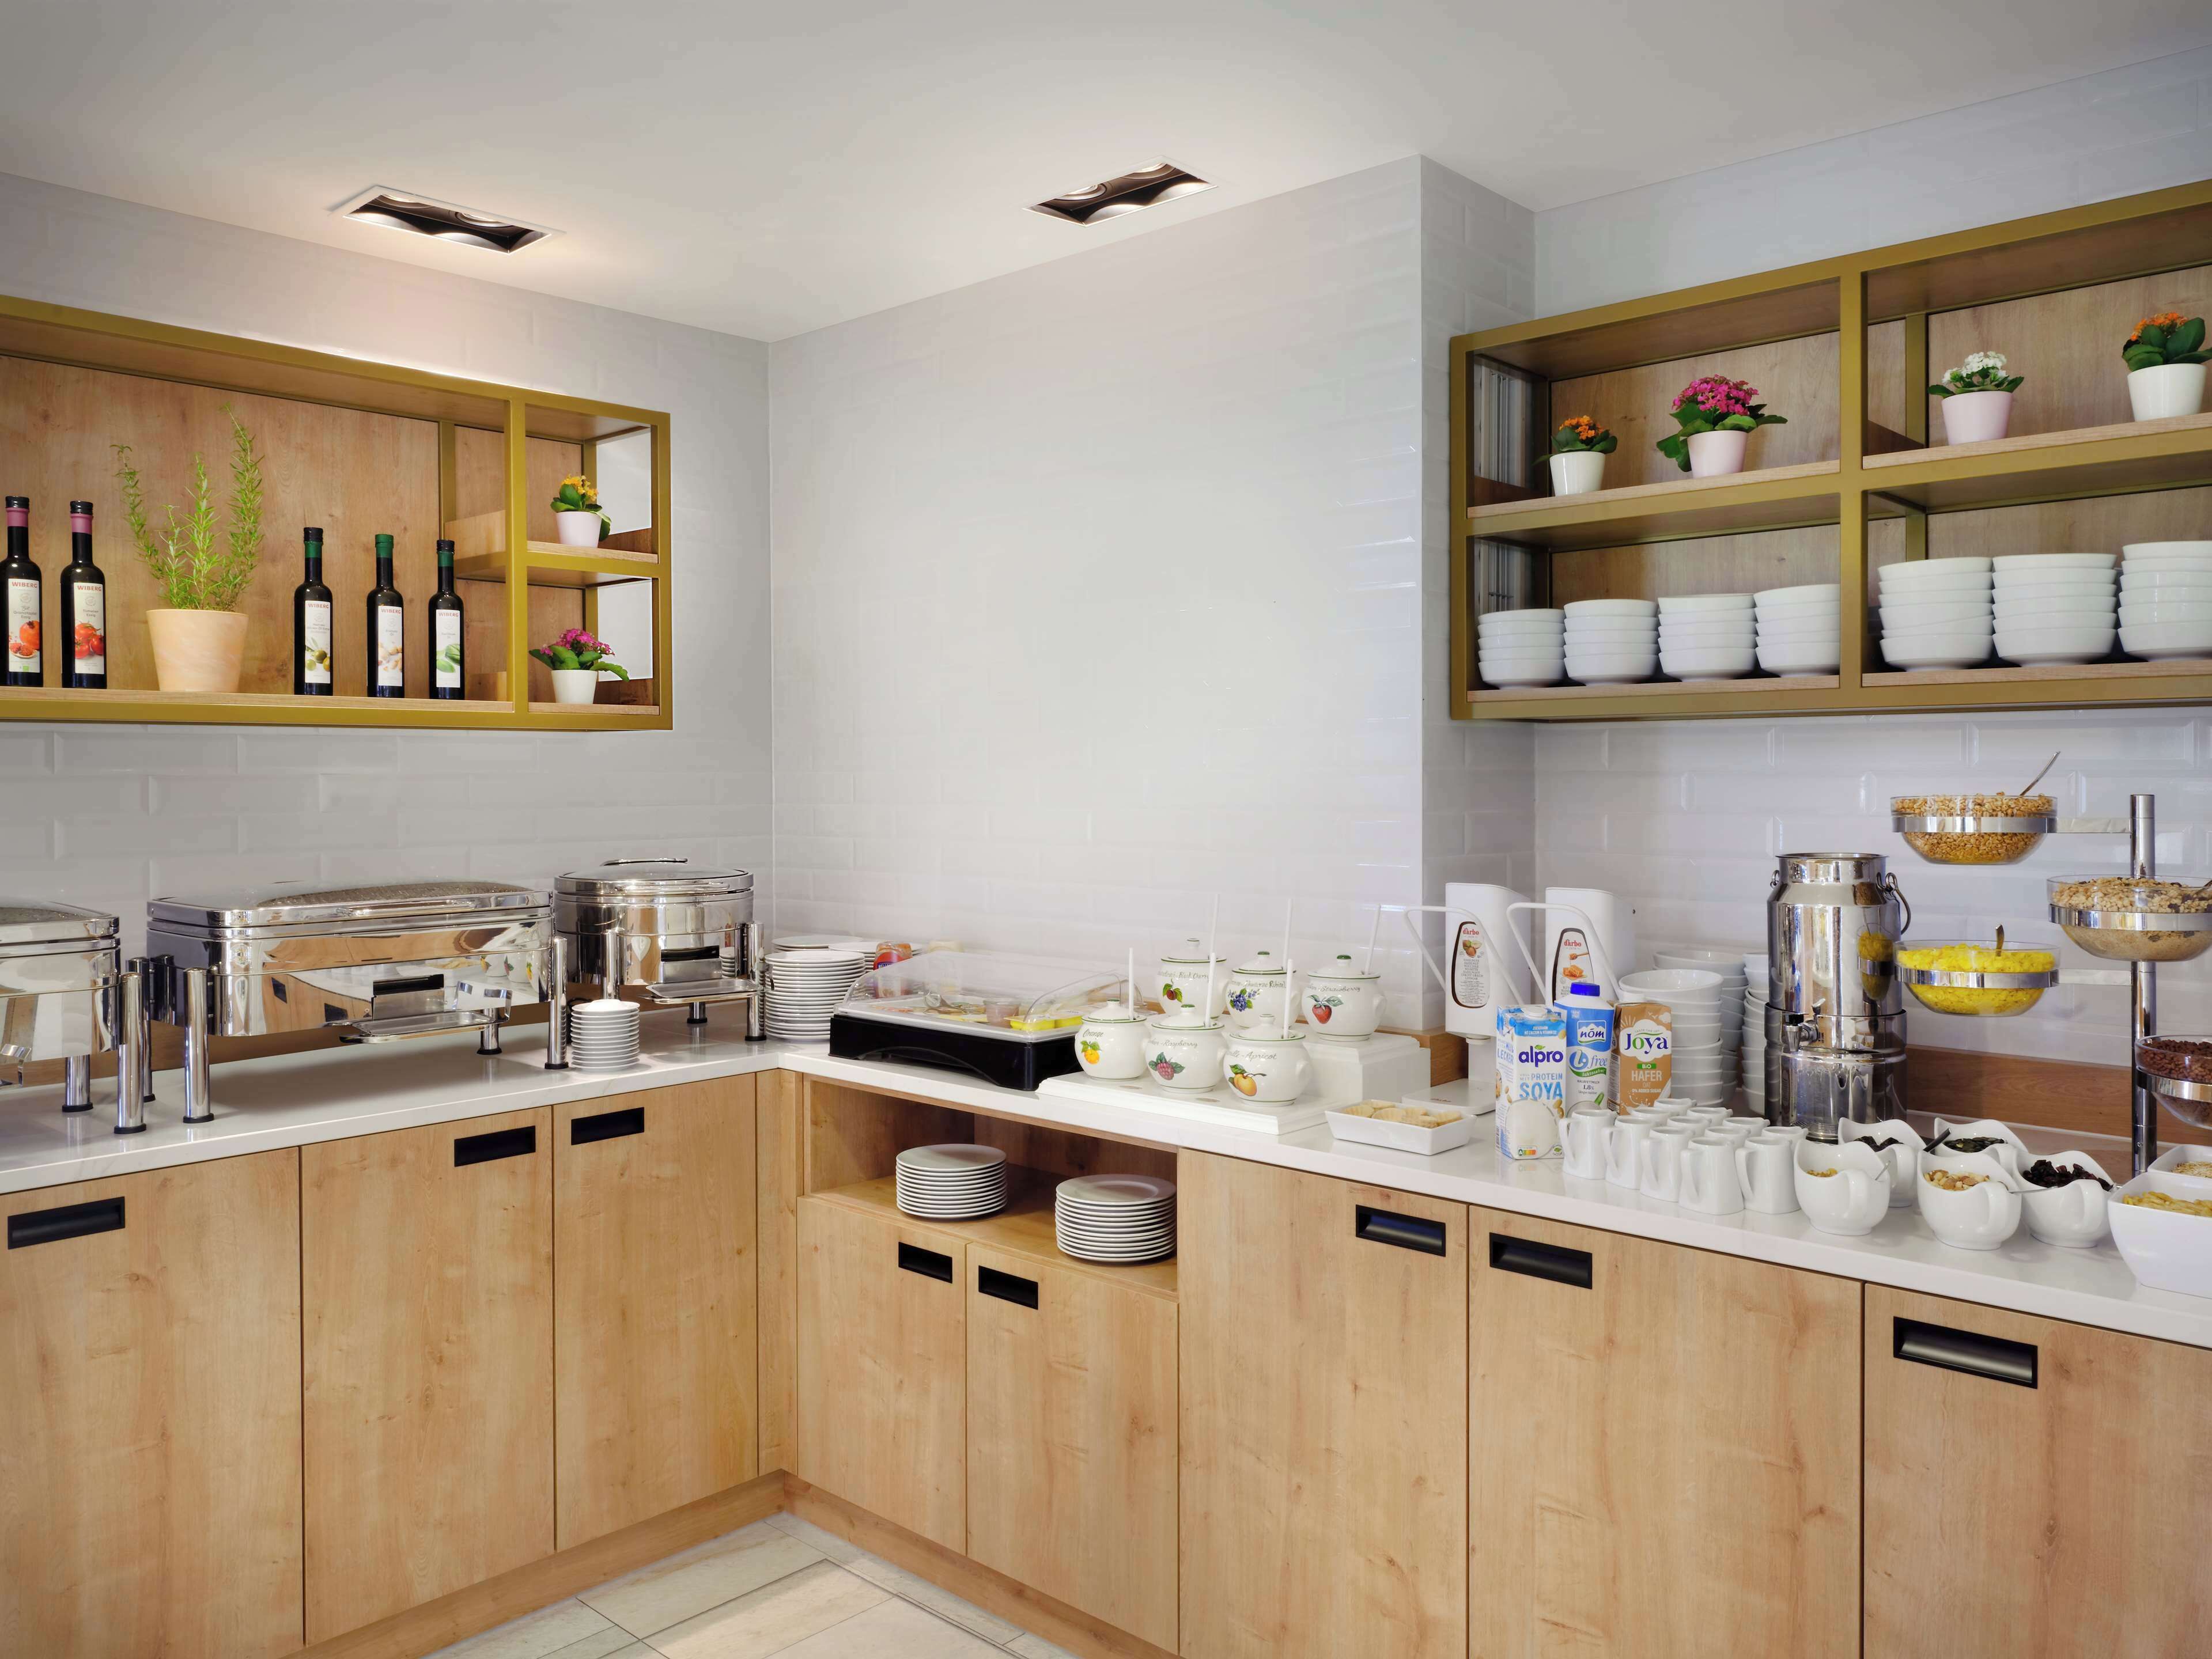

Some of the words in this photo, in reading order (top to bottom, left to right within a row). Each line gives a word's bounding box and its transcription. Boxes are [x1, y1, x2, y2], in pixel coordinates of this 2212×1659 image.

[1624, 1033, 1669, 1054] Joya
[1518, 1046, 1564, 1067] alpro
[1531, 1073, 1563, 1081] PROTEIN
[1631, 1070, 1662, 1081] HAFER
[1519, 1082, 1563, 1101] SOYA
